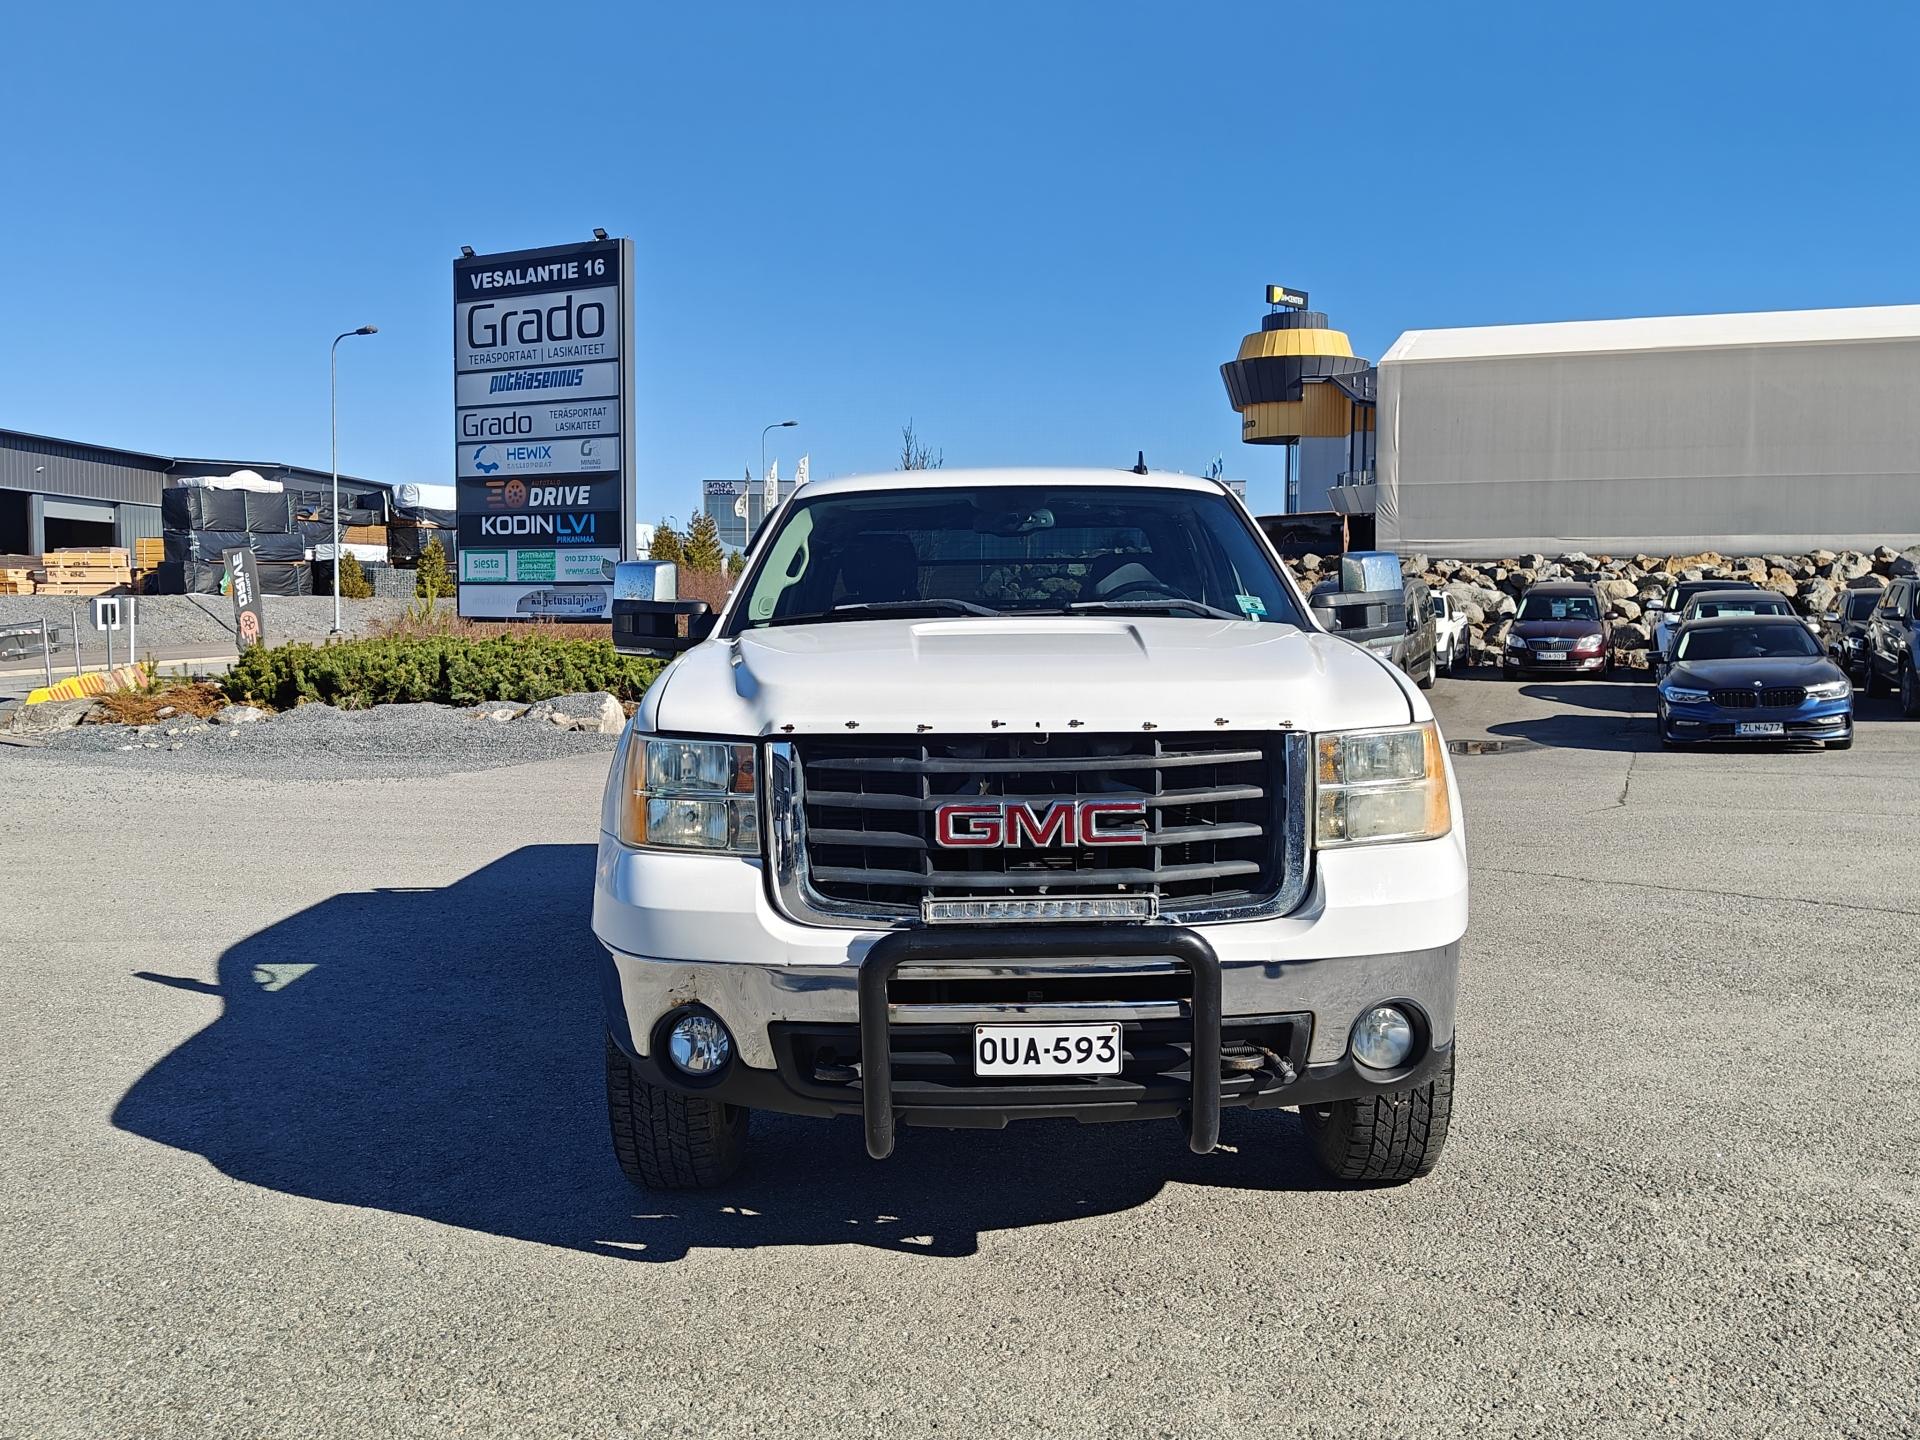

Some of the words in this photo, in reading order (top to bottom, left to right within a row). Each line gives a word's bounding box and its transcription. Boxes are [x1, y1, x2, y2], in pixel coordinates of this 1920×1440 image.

[471, 262, 578, 290] VESALANTIE
[584, 258, 605, 276] 16
[467, 294, 605, 349] Grado
[468, 349, 537, 365] TERÄSPORTAAT
[547, 343, 605, 359] LASIKAITEET
[489, 368, 584, 394] putkiasennus
[549, 406, 607, 419] TERÄSPORTAAT
[463, 411, 532, 437] Grado
[555, 420, 601, 432] LASIKAITEET
[507, 446, 552, 460] HEWIX
[529, 485, 591, 507] DRIVE
[706, 481, 734, 489] smart
[707, 488, 736, 496] vatten
[556, 535, 595, 544] PIRKANMAA
[473, 558, 499, 569] siesta
[935, 800, 1147, 848] GMC
[979, 1035, 1116, 1065] OUA-593
